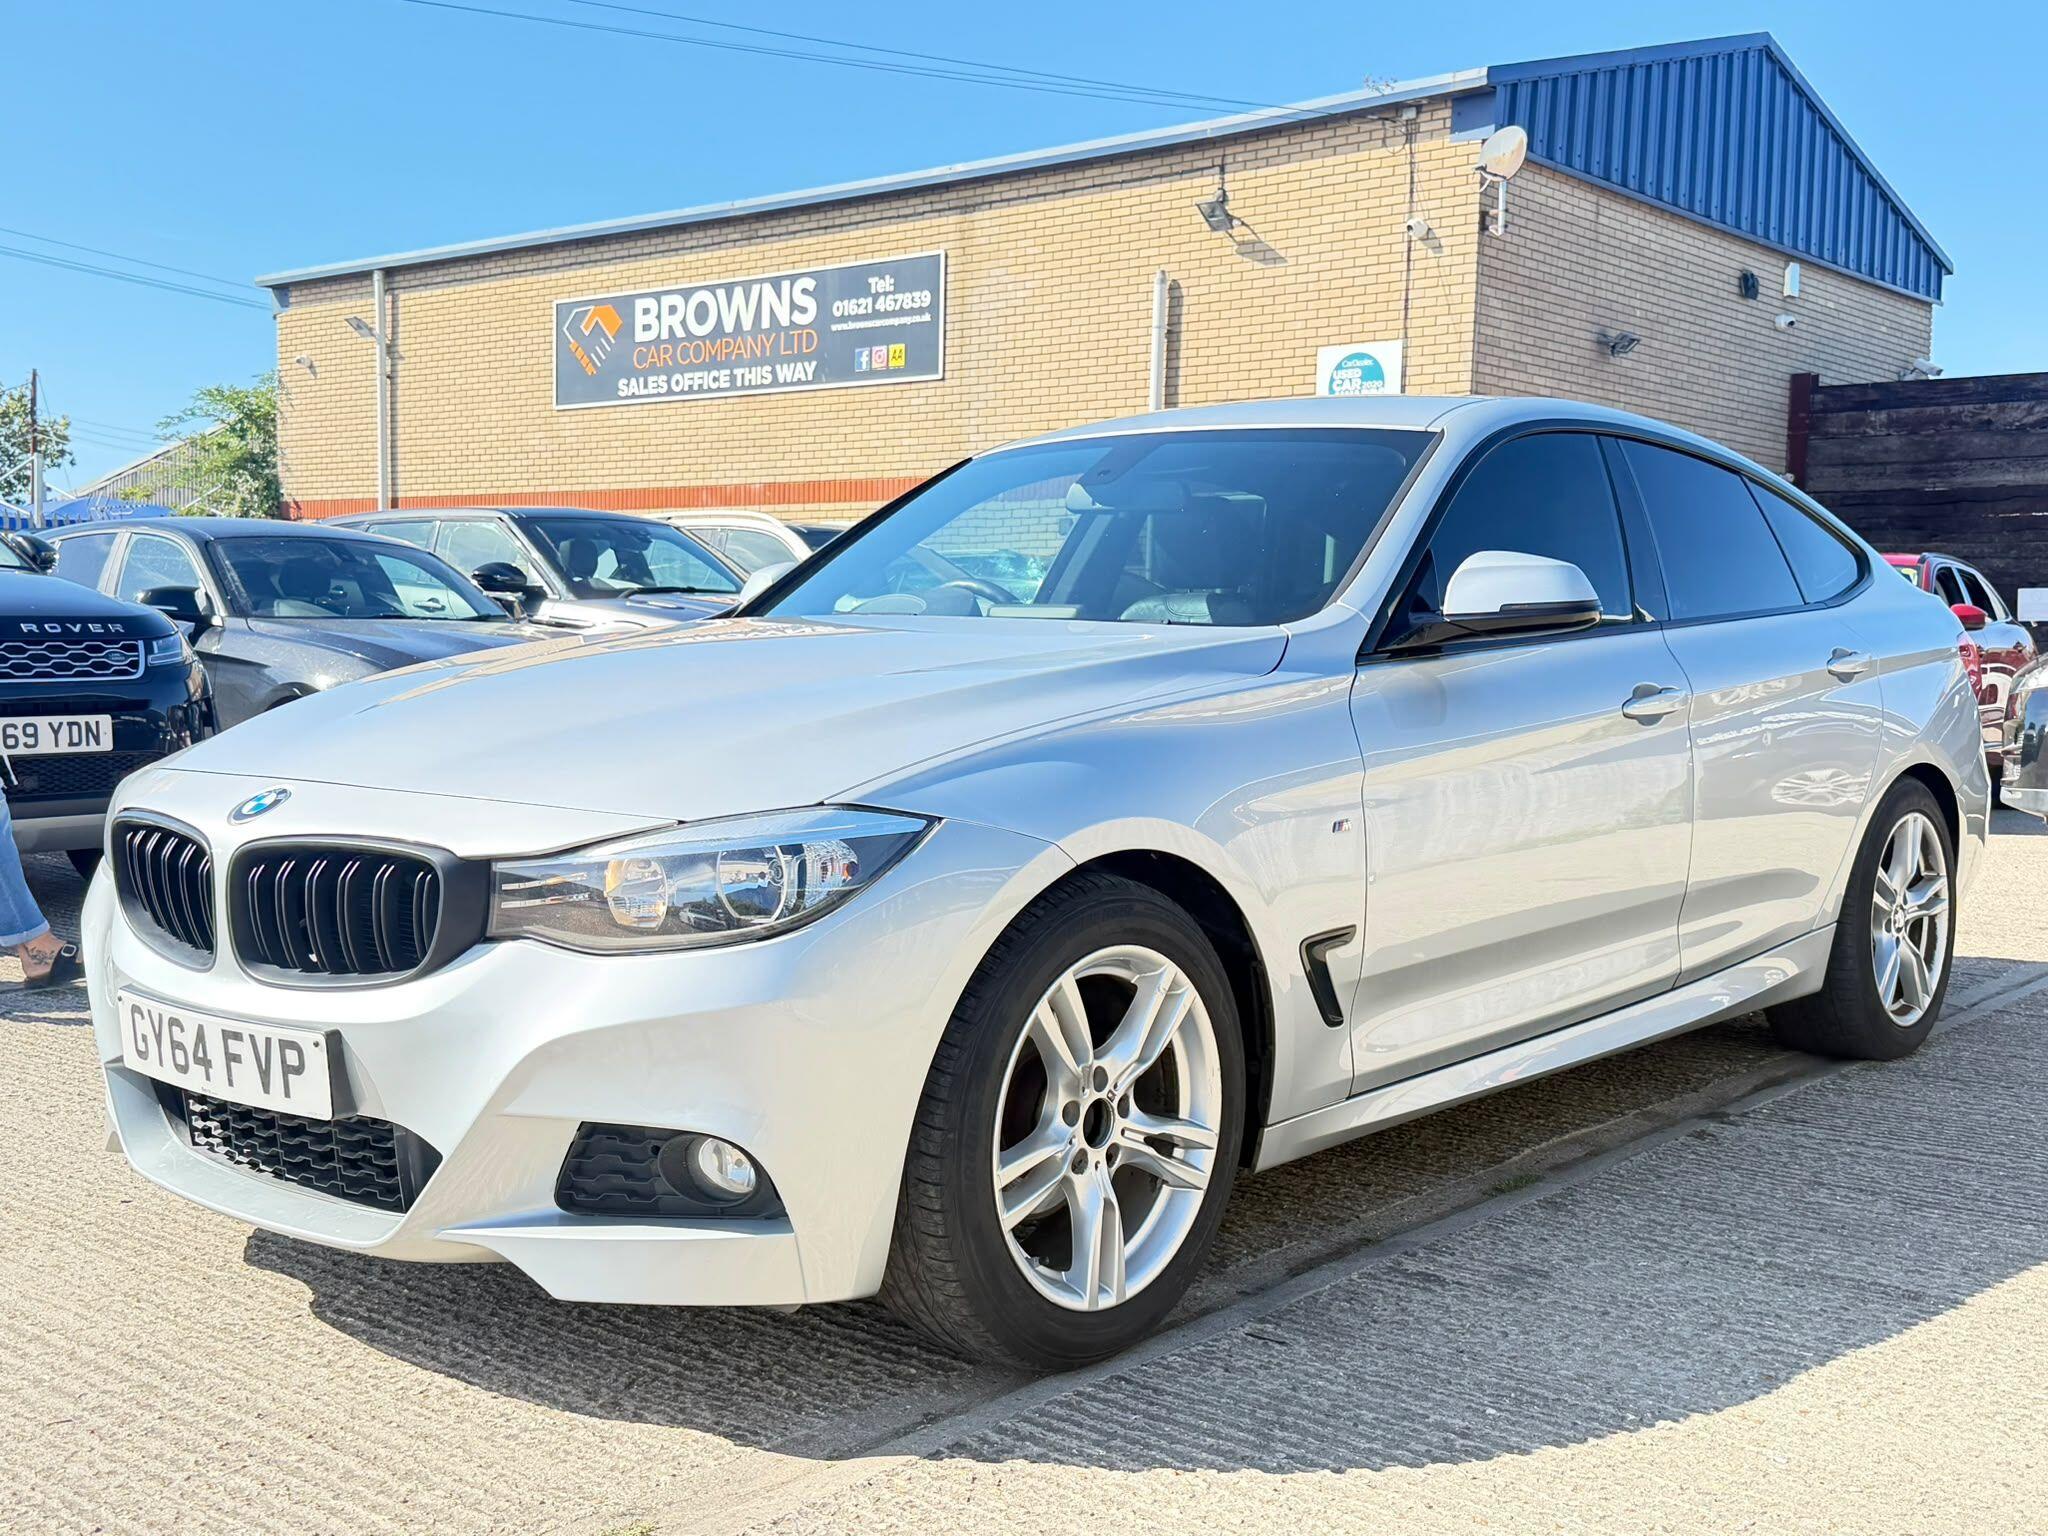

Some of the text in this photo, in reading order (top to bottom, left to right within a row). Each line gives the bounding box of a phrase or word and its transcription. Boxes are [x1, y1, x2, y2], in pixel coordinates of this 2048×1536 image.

[868, 274, 895, 294] Tel:
[634, 276, 818, 343] BROWNS
[832, 290, 931, 317] 01621 467839
[633, 328, 818, 369] CAR COMPANY LTD
[617, 361, 818, 397] SALES OFFICE THIS WAY
[1332, 378, 1362, 391] CAR
[1333, 368, 1362, 379] USED
[20, 623, 125, 633] ROVER
[2, 720, 101, 750] 69 YDN
[131, 1003, 306, 1099] GY64 FVP
